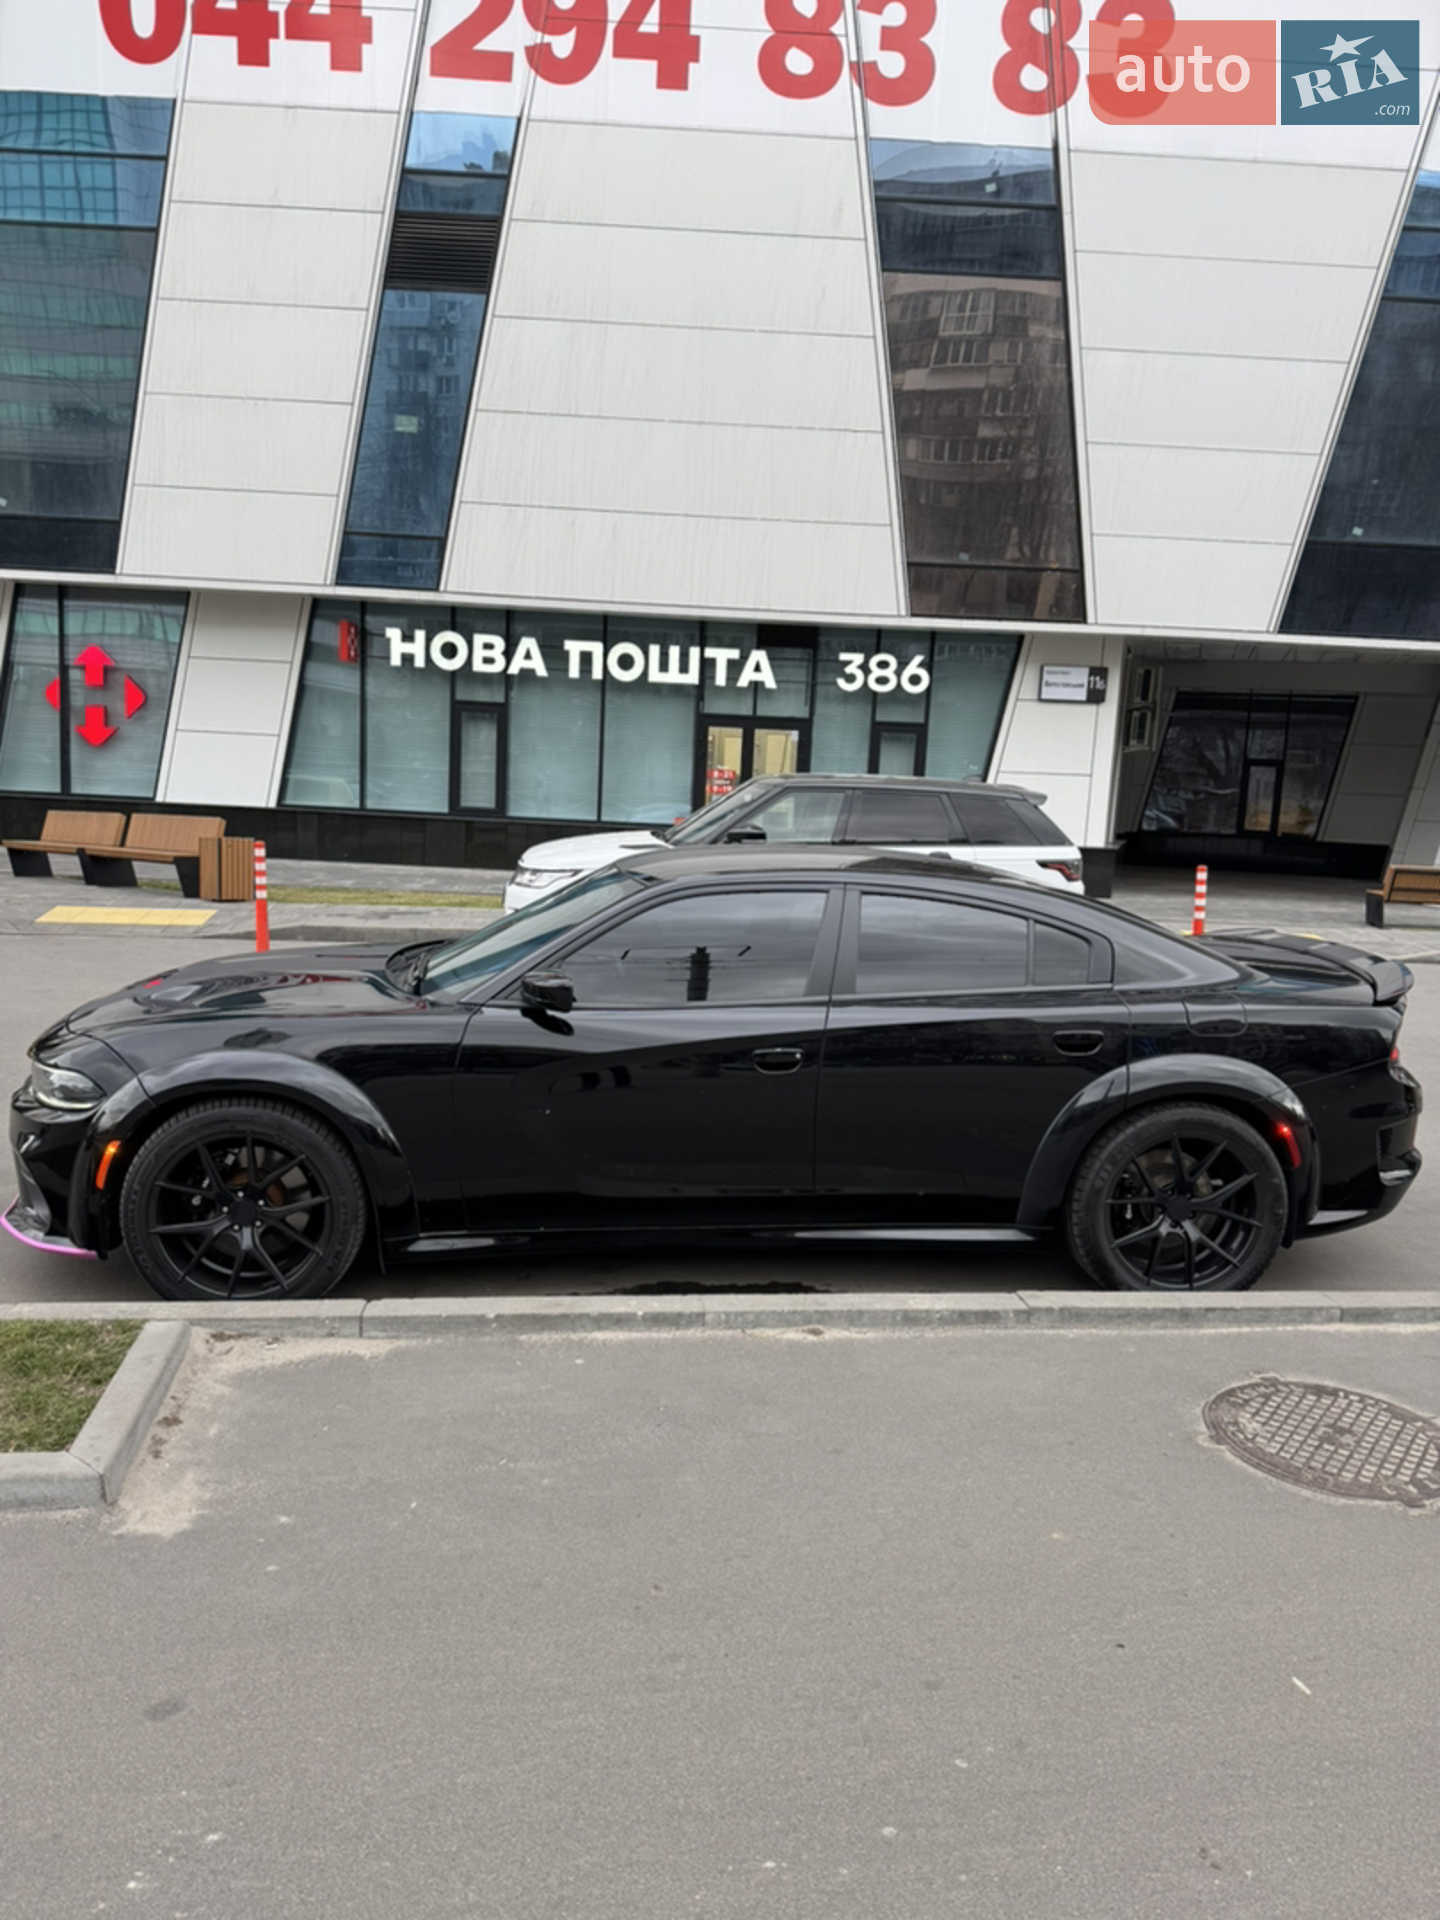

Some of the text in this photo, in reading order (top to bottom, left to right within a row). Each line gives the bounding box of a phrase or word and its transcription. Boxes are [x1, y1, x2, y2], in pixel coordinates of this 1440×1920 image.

[429, 0, 701, 91] 294
[757, 0, 937, 108] 83
[992, 0, 1176, 118] 83
[385, 627, 932, 695] НОВА ПОШТА 386
